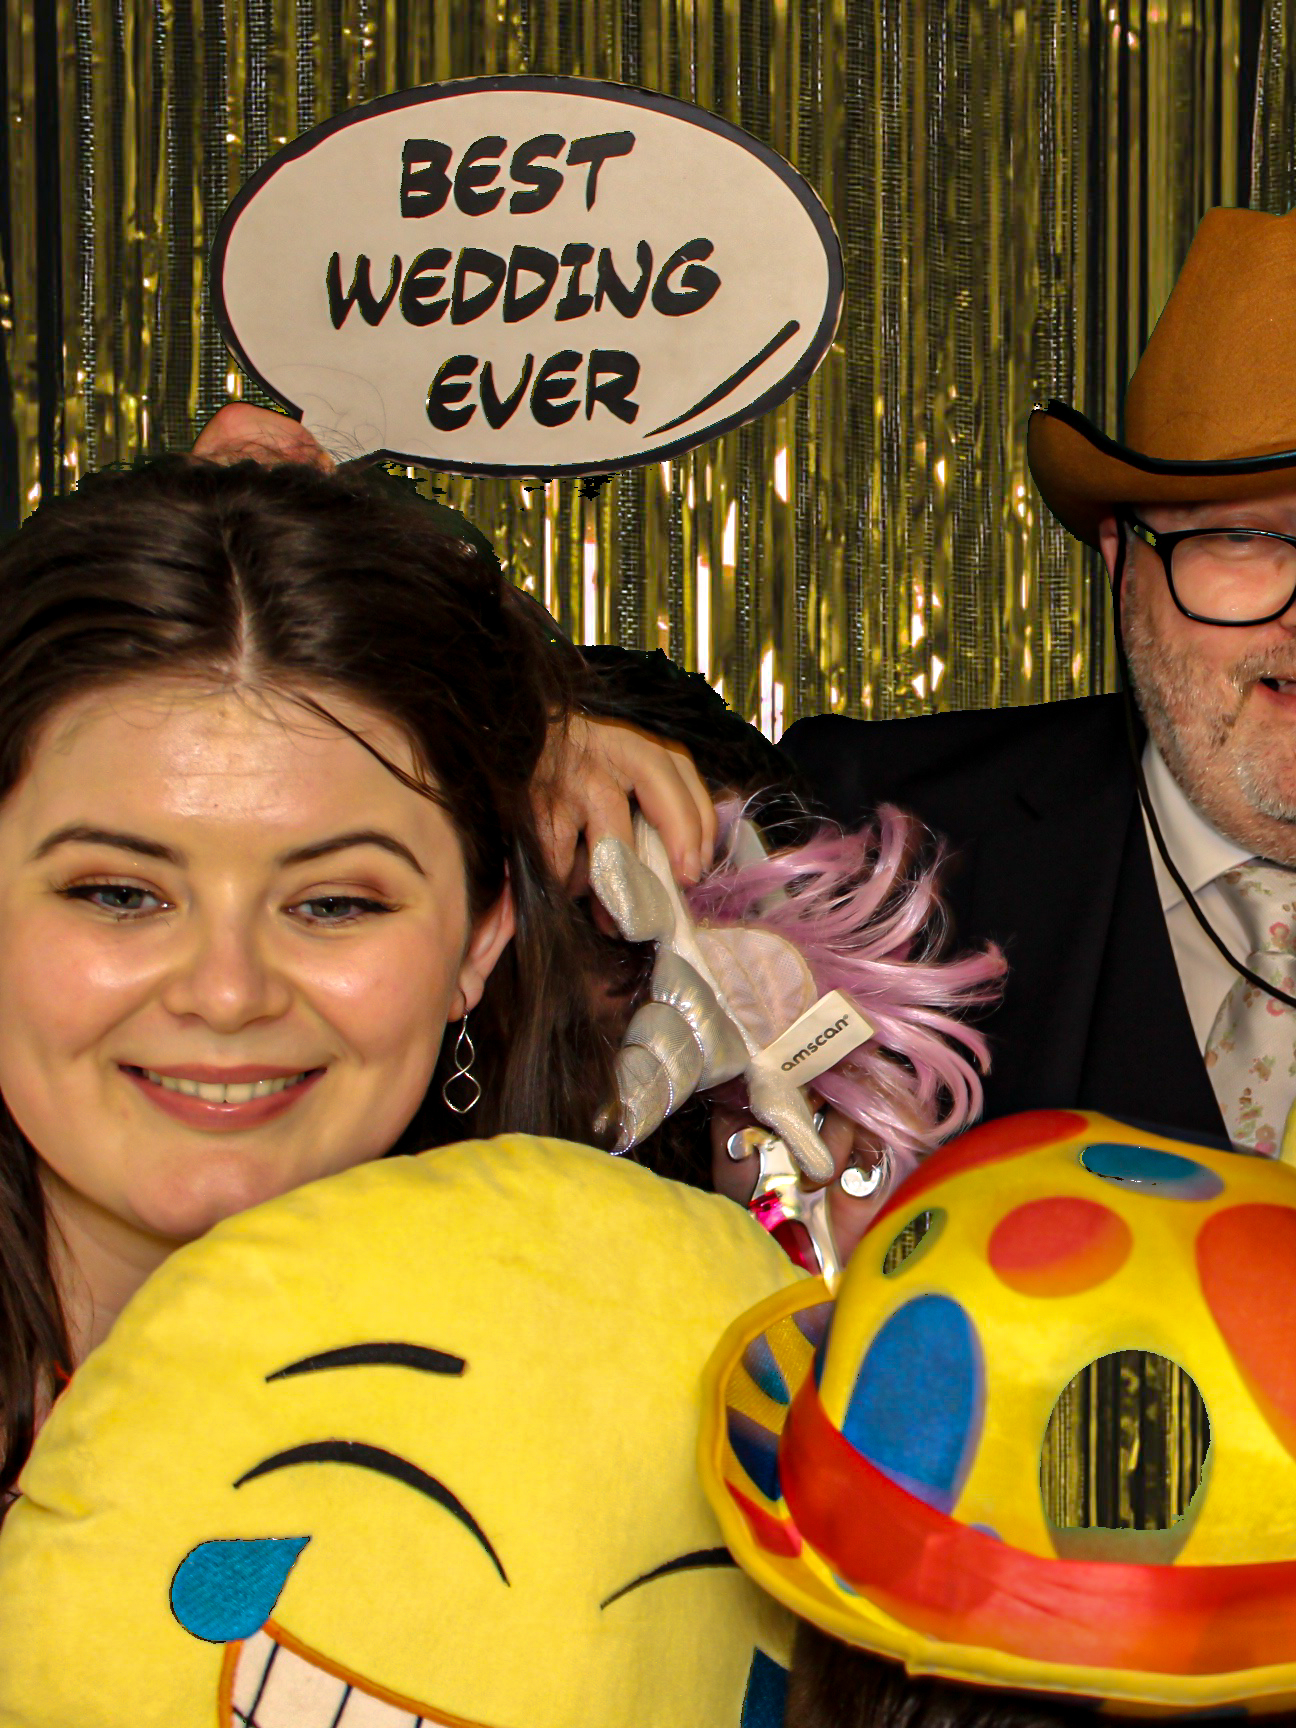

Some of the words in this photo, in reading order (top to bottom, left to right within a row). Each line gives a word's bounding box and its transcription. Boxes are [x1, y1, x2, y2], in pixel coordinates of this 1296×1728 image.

[400, 131, 636, 218] BEST
[326, 237, 722, 330] WEDDING
[425, 349, 640, 431] EVER
[780, 1018, 849, 1072] amscan
